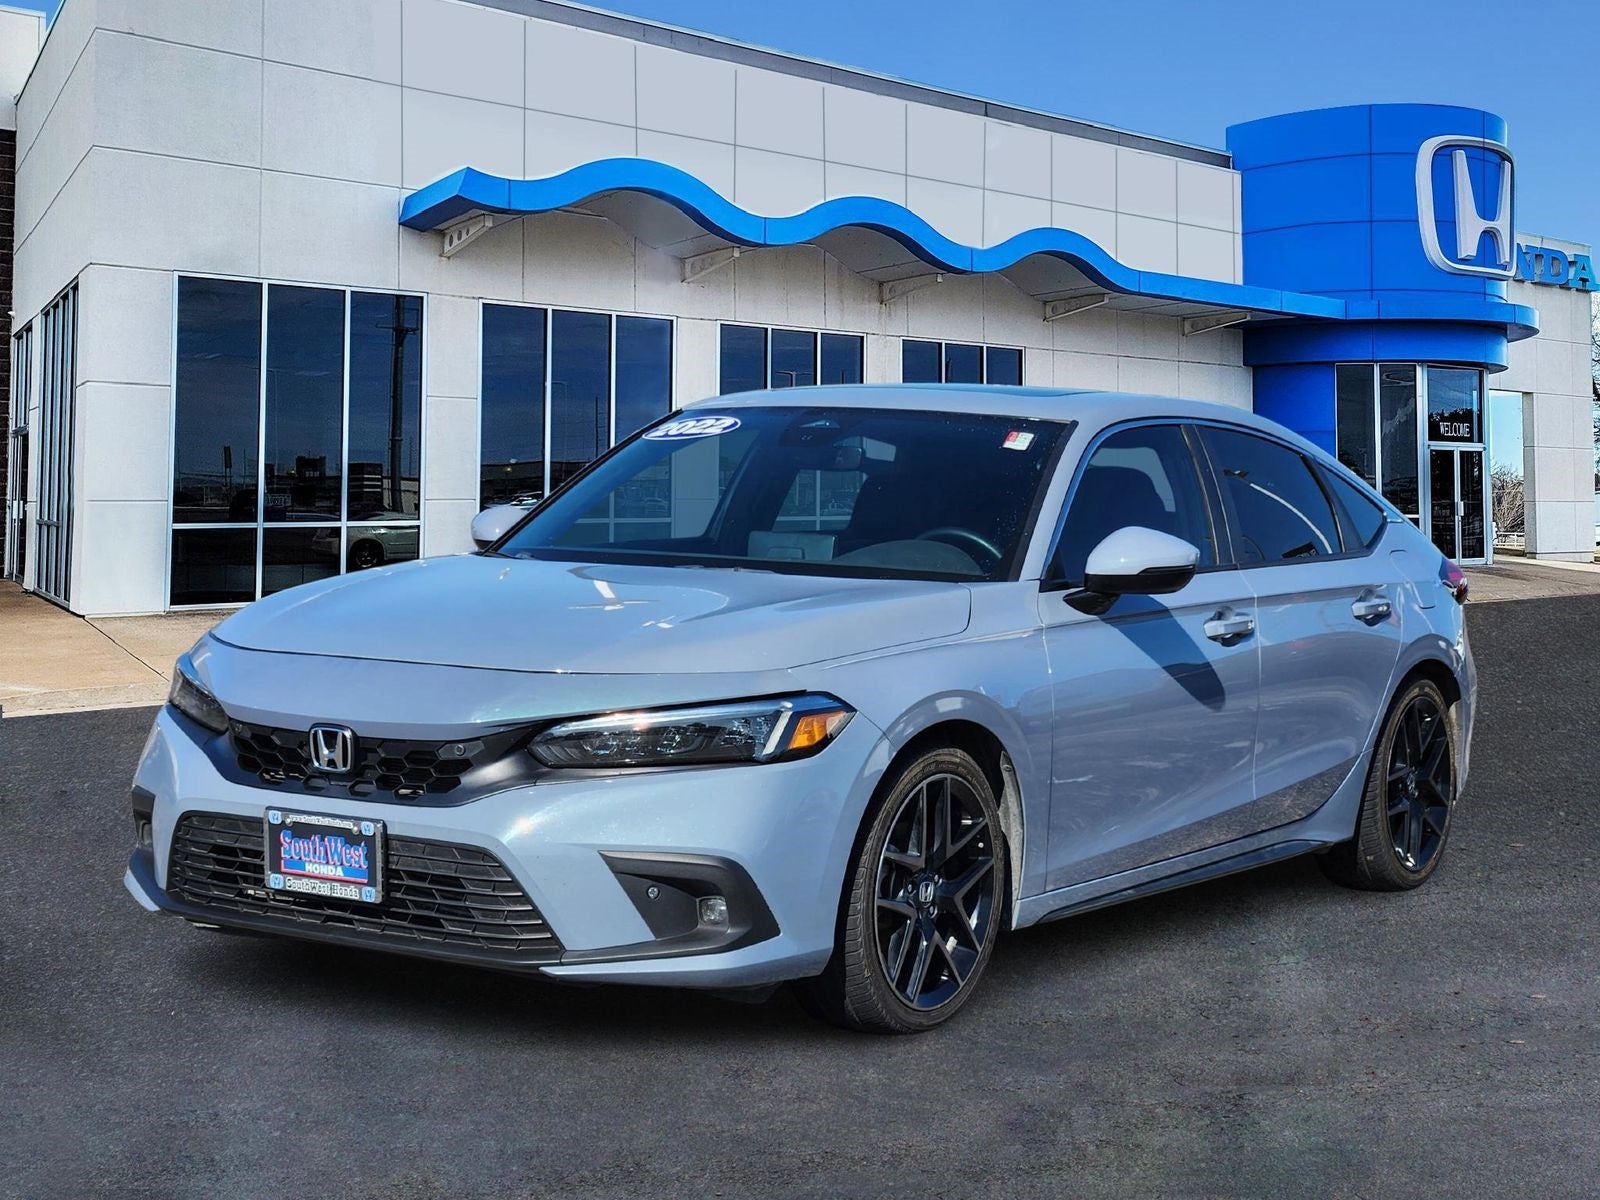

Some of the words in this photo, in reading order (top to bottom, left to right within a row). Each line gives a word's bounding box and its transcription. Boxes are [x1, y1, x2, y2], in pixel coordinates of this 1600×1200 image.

[1515, 242, 1600, 291] NDA
[645, 419, 735, 437] 2022
[1440, 422, 1470, 437] WELCOME
[280, 829, 368, 868] SouthWest
[304, 863, 344, 877] HONDA
[286, 877, 330, 895] SouthWest
[331, 882, 360, 899] Honda
